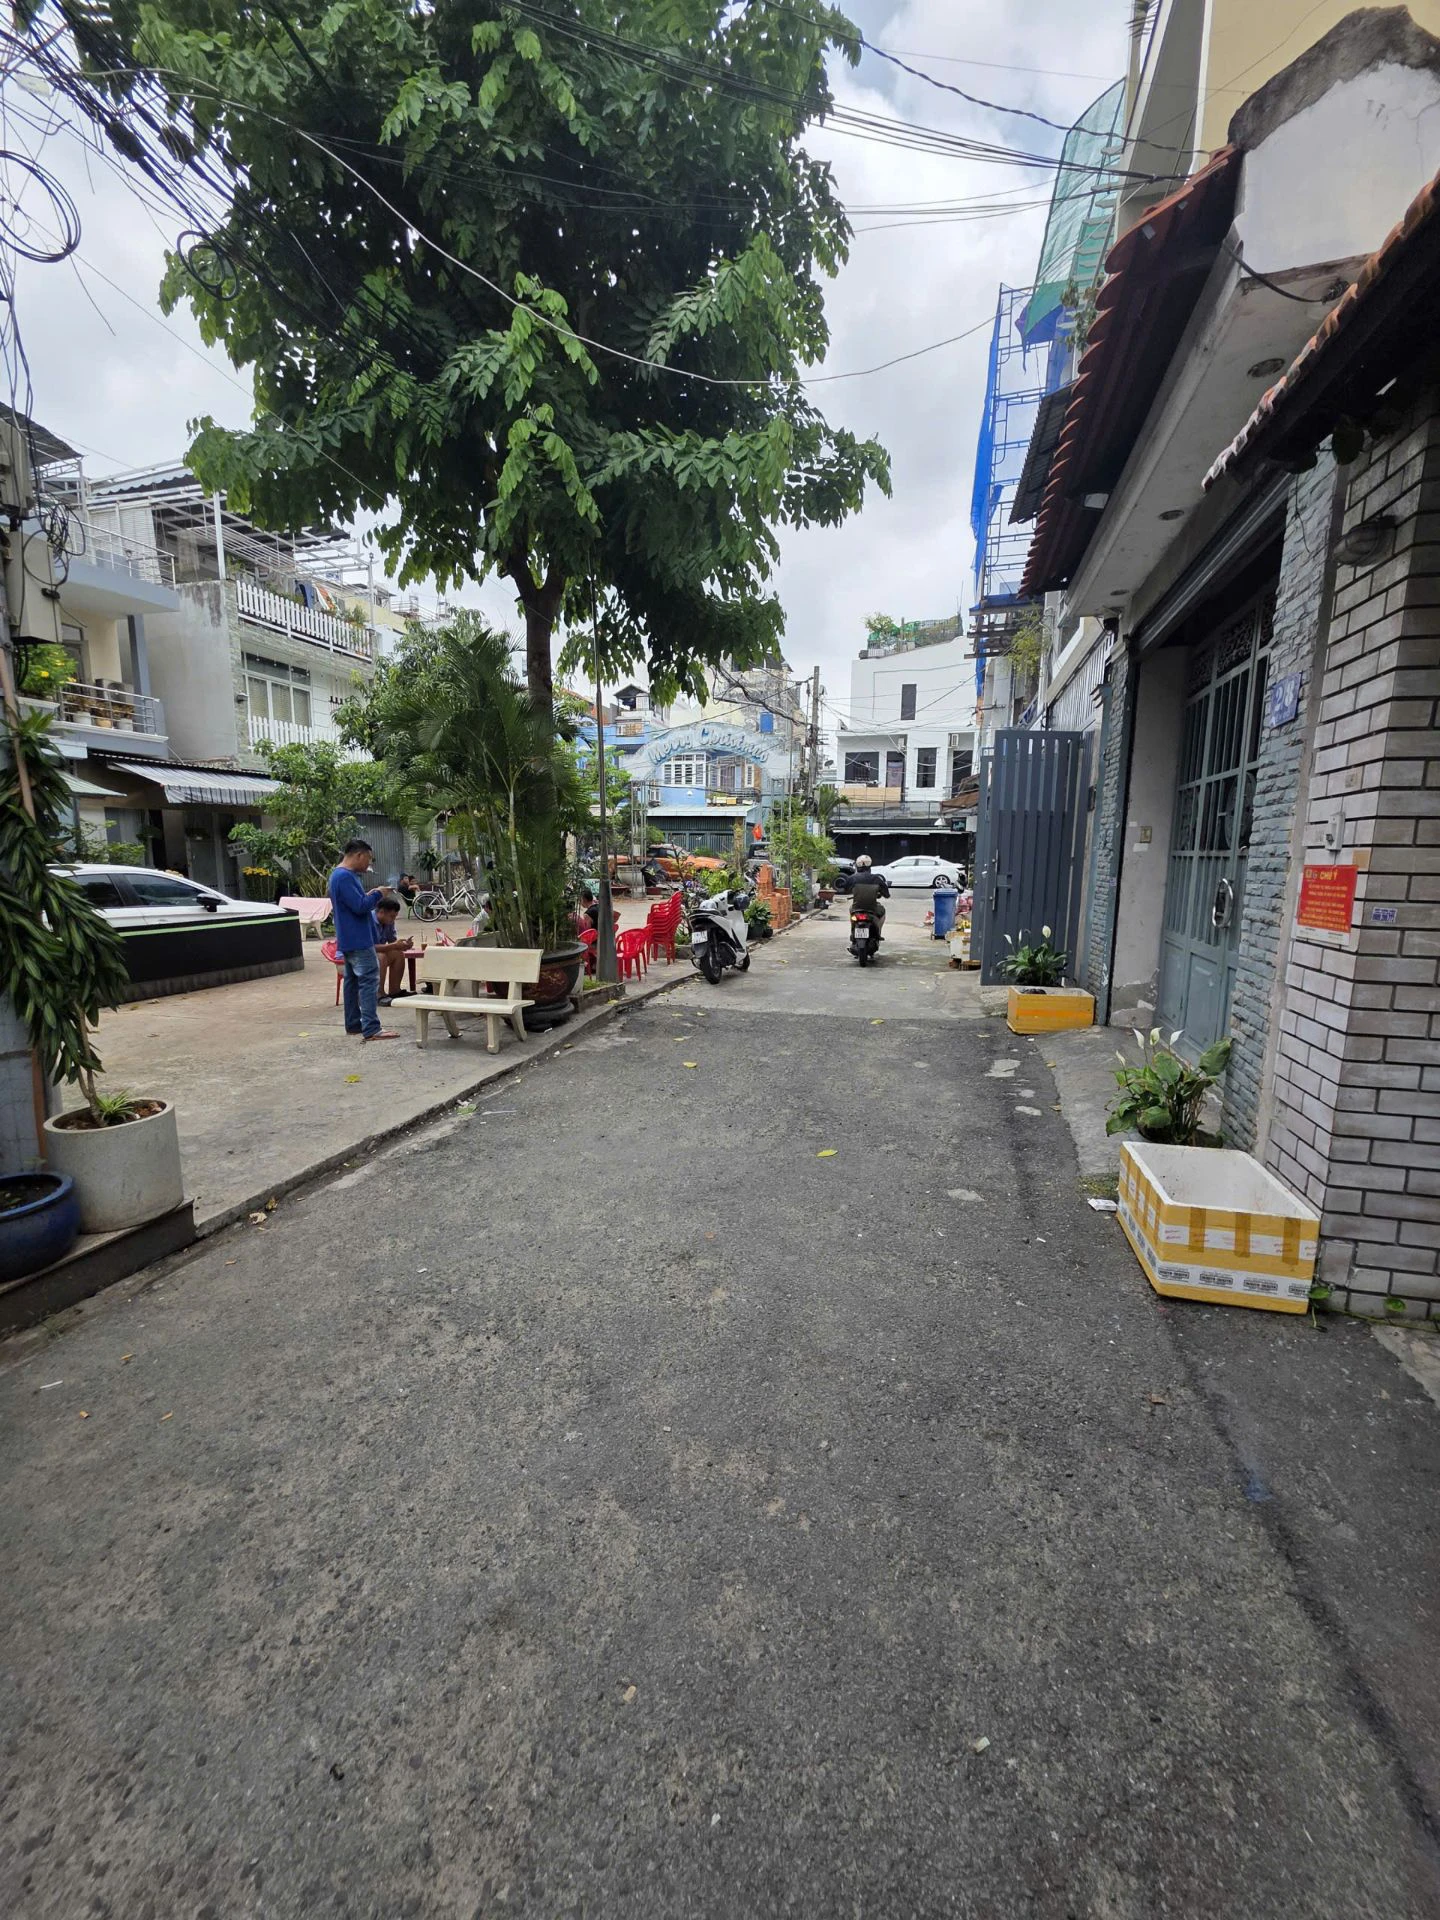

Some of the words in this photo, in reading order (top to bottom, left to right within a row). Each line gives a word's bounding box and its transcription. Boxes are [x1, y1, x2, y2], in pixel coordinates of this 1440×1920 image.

[1274, 679, 1295, 711] 28
[648, 736, 692, 764] Merry
[700, 728, 768, 762] Christmas
